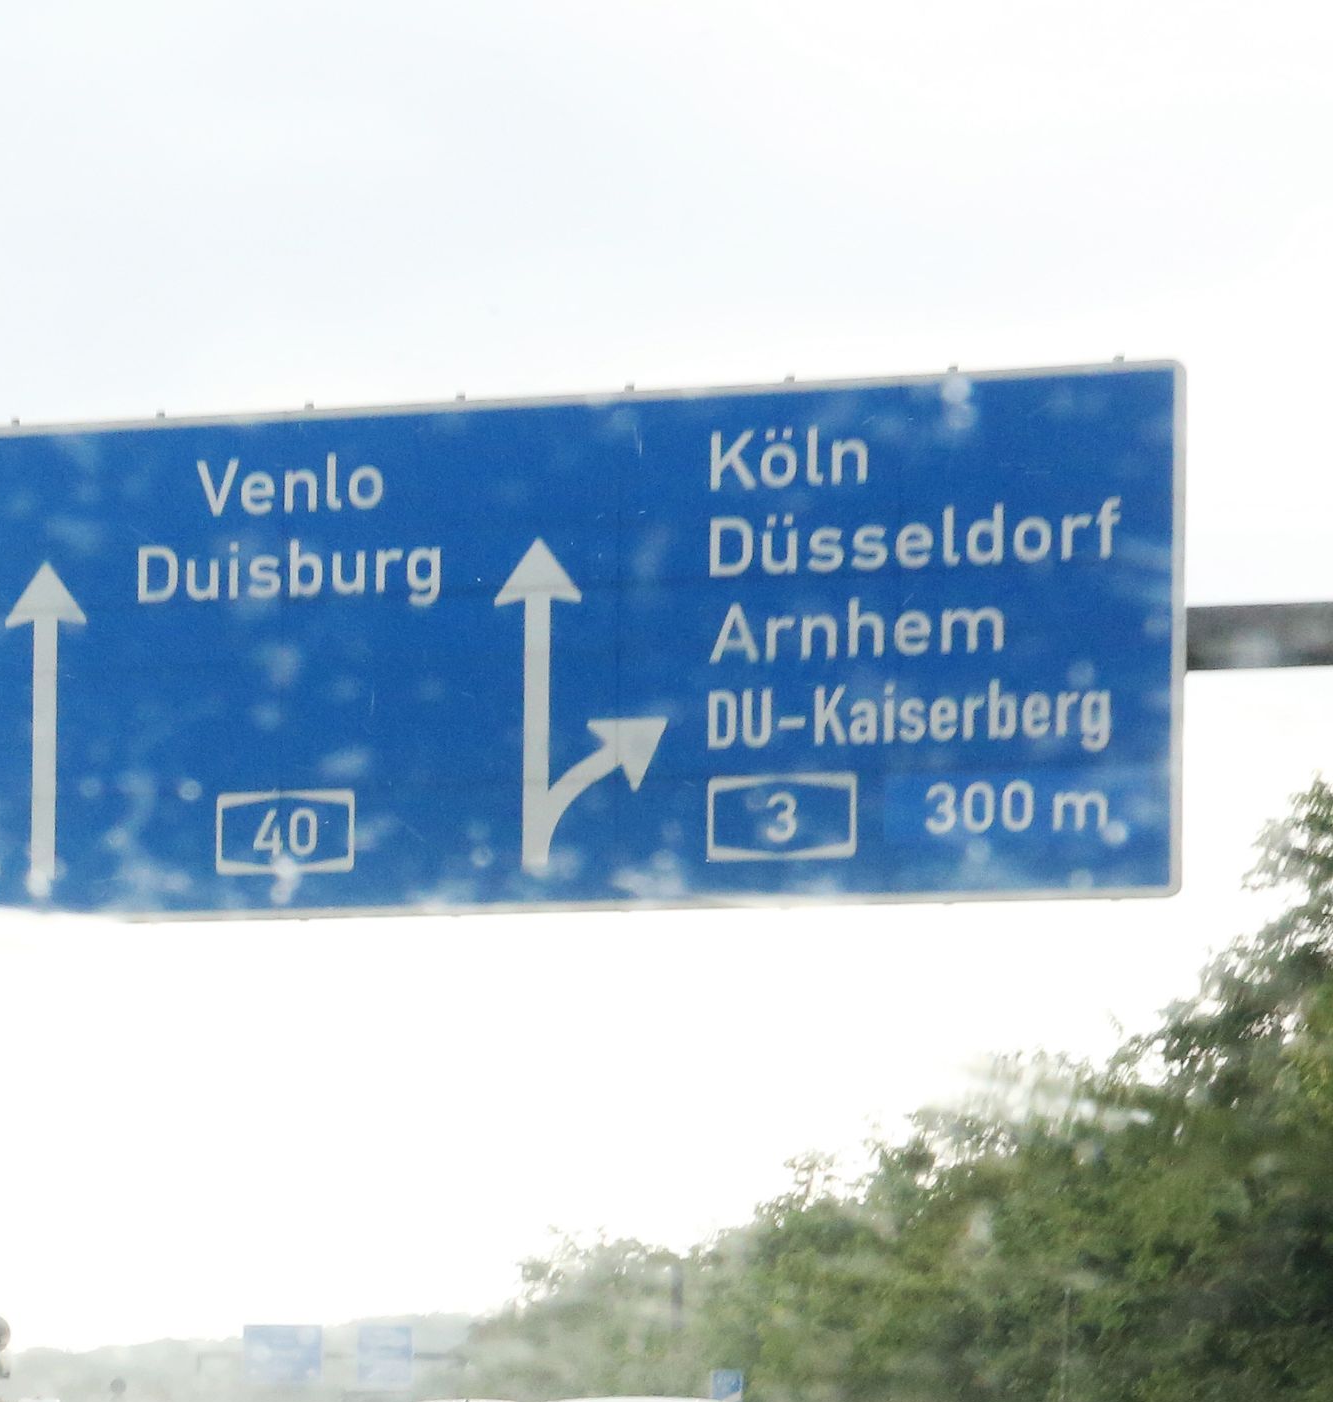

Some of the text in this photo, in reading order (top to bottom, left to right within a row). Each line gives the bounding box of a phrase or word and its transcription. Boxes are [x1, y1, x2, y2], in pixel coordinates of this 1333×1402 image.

[197, 454, 383, 516] Venlo
[710, 427, 868, 490] Köln
[709, 499, 1121, 576] Düsseldorf
[137, 539, 441, 605] Duisburg
[710, 599, 1005, 662] Arnhem
[708, 681, 1111, 751] DU-Kaiserberg
[253, 807, 318, 857] 40
[765, 791, 798, 843] 3
[925, 780, 1109, 835] 300 m
